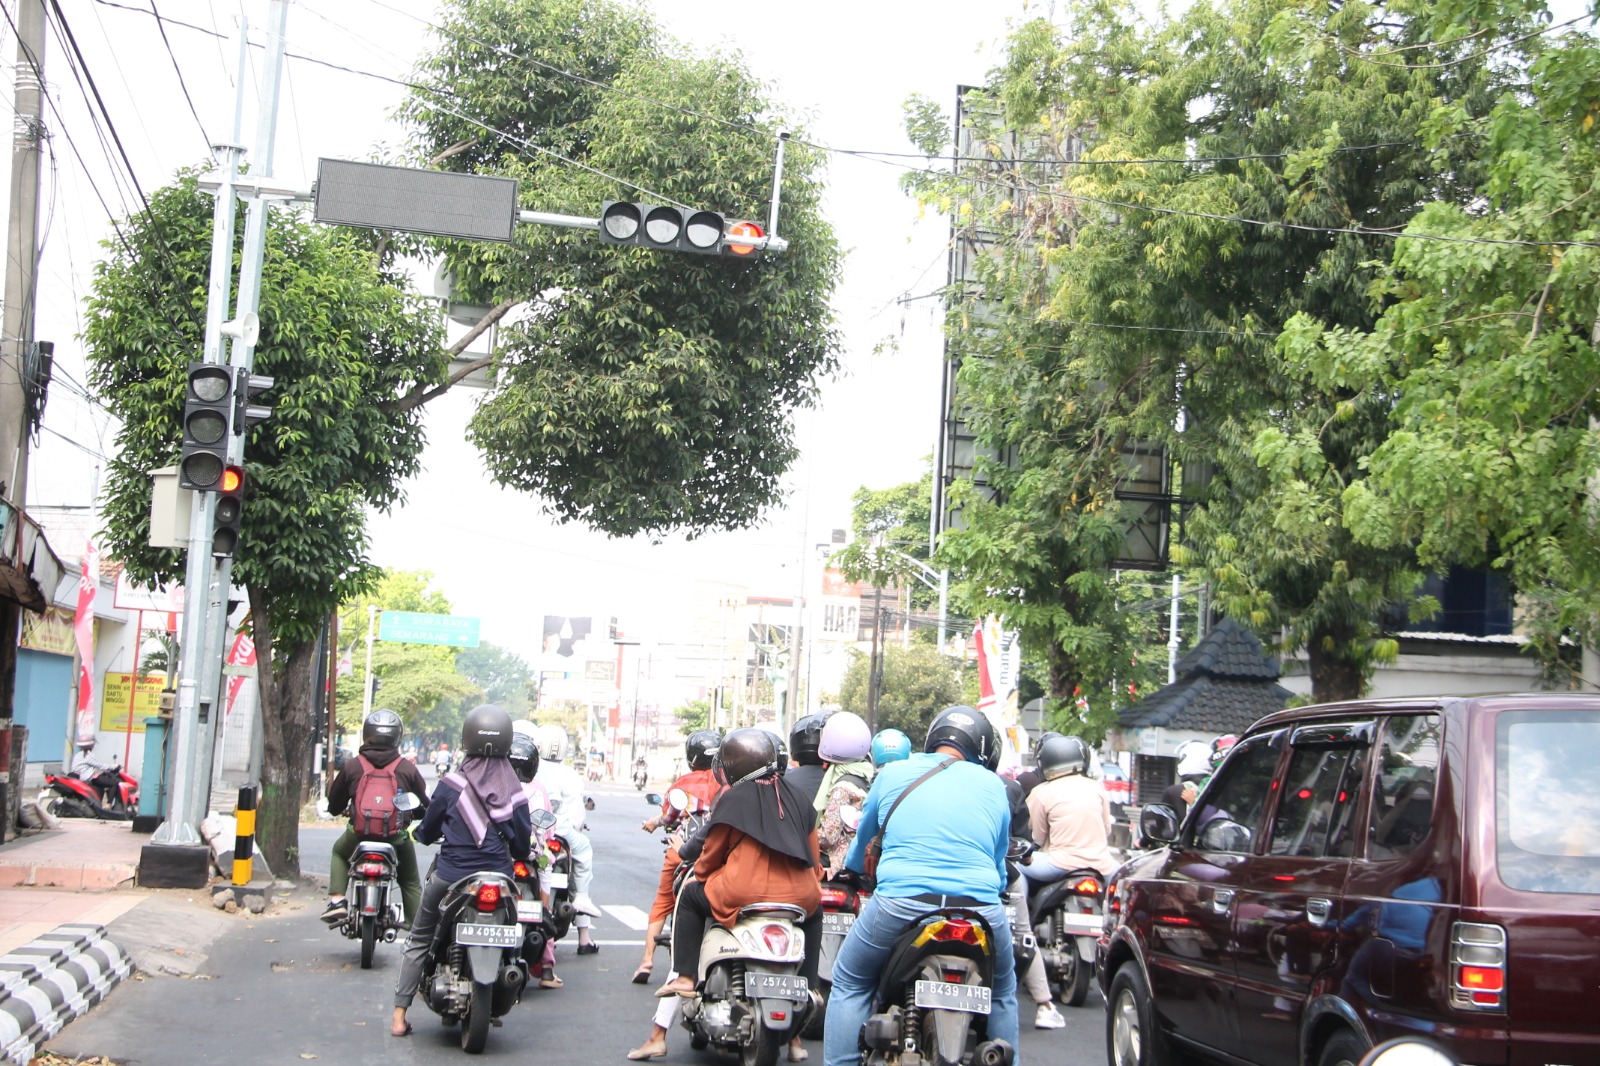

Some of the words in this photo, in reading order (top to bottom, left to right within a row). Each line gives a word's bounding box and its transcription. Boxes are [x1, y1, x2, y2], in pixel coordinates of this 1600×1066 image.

[390, 629, 449, 642] SEMARANG
[999, 632, 1012, 685] mandir
[476, 926, 502, 937] 4054
[503, 928, 515, 938] XK
[749, 975, 756, 986] K
[762, 976, 787, 988] 2574
[793, 979, 806, 990] UR
[917, 983, 924, 993] H
[930, 982, 959, 997] 6439
[966, 987, 989, 1000] AHE
